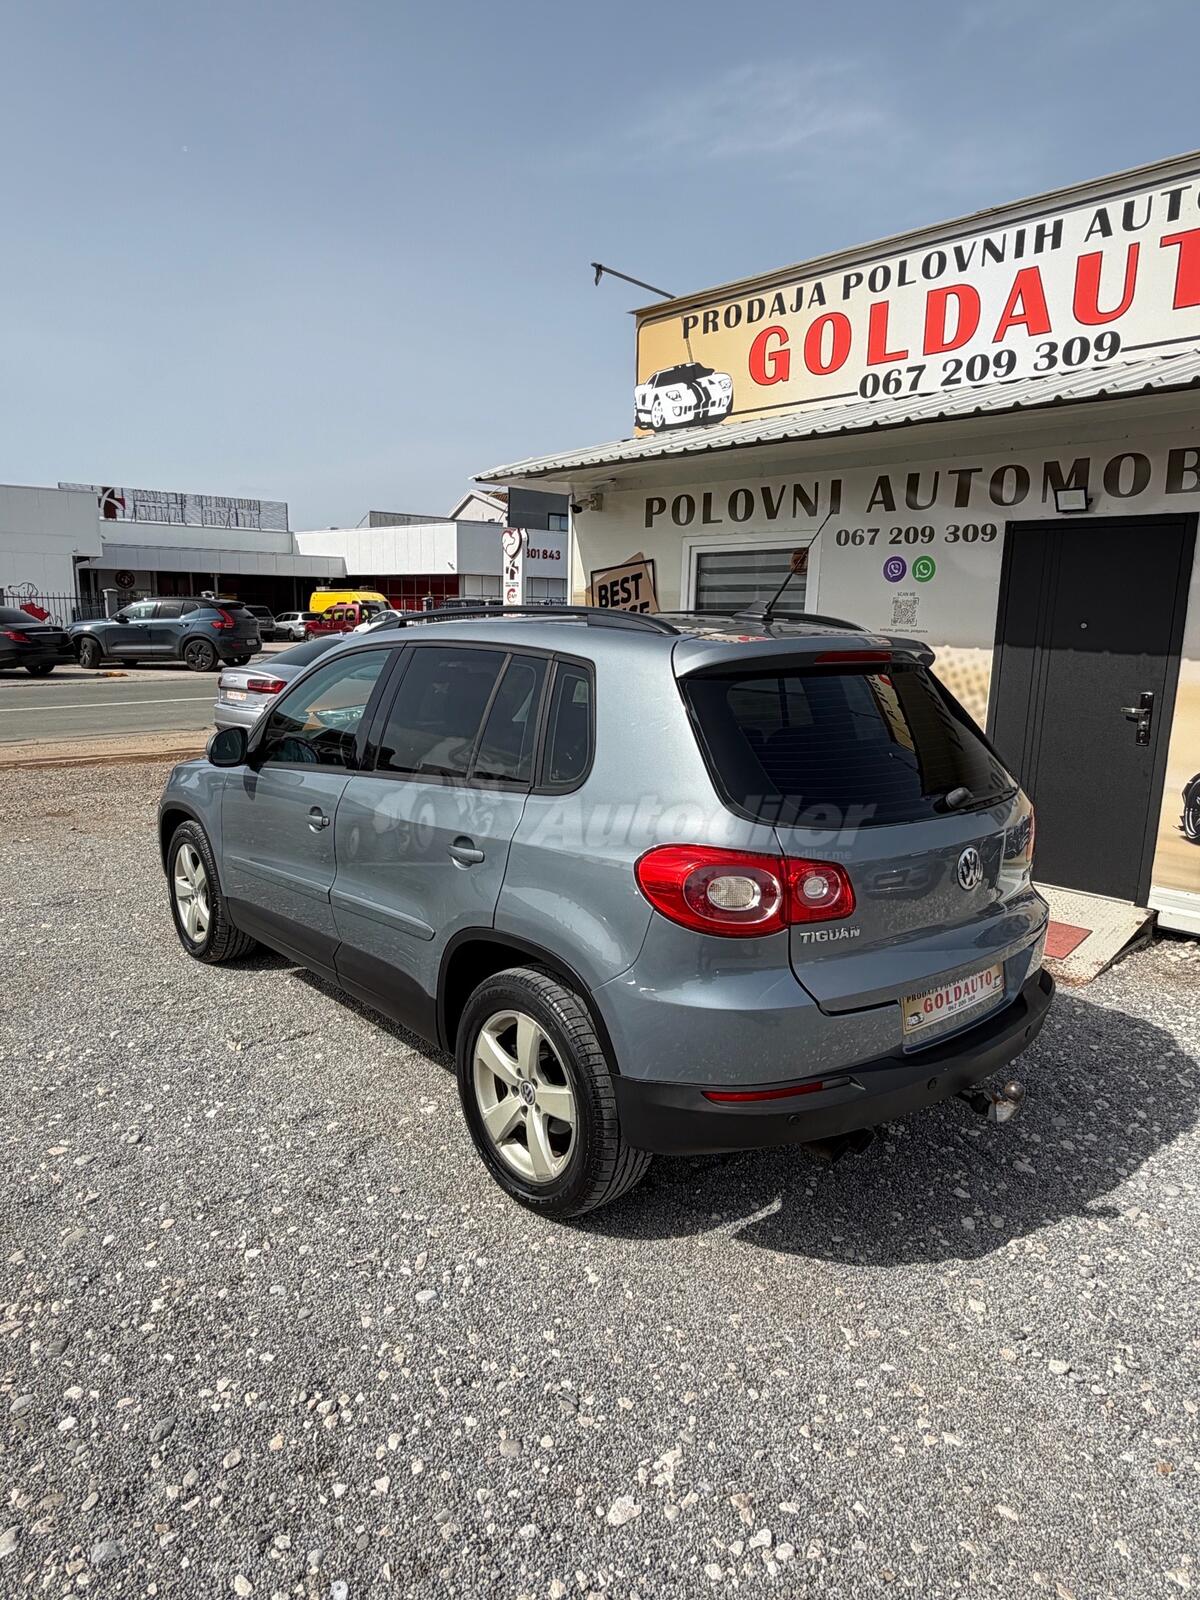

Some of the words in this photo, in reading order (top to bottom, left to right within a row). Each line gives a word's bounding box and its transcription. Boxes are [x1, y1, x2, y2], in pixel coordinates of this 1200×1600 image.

[682, 281, 827, 339] PRODAJA
[842, 217, 1063, 302] POLOVNIH
[1083, 184, 1200, 243] AUT
[859, 364, 927, 399] 067
[940, 349, 1016, 387] 209
[1033, 330, 1122, 373] 309
[644, 478, 843, 529] POLOVNI
[835, 528, 880, 546] 067
[888, 525, 935, 545] 209
[944, 523, 997, 543] 309
[542, 549, 561, 560] 843
[598, 572, 643, 608] BEST
[800, 926, 861, 944] TIGUAN
[923, 971, 992, 1013] GOLDAUTO
